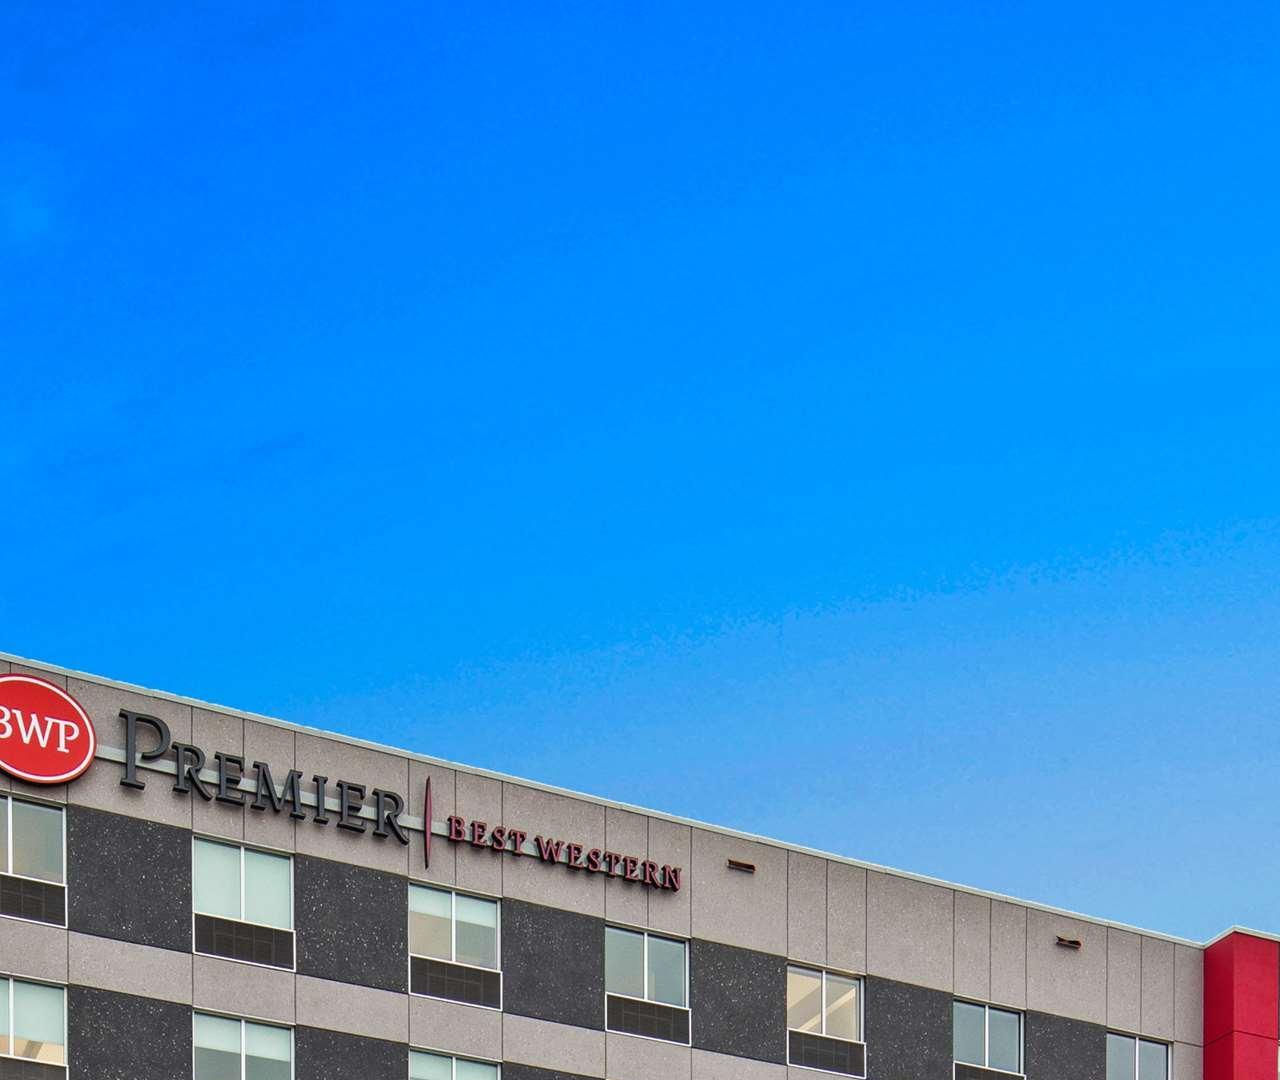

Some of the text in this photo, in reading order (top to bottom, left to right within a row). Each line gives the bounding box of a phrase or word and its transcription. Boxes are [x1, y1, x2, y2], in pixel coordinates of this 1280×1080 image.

[118, 708, 410, 846] PREMIER
[447, 815, 683, 893] BEST WESTERN
